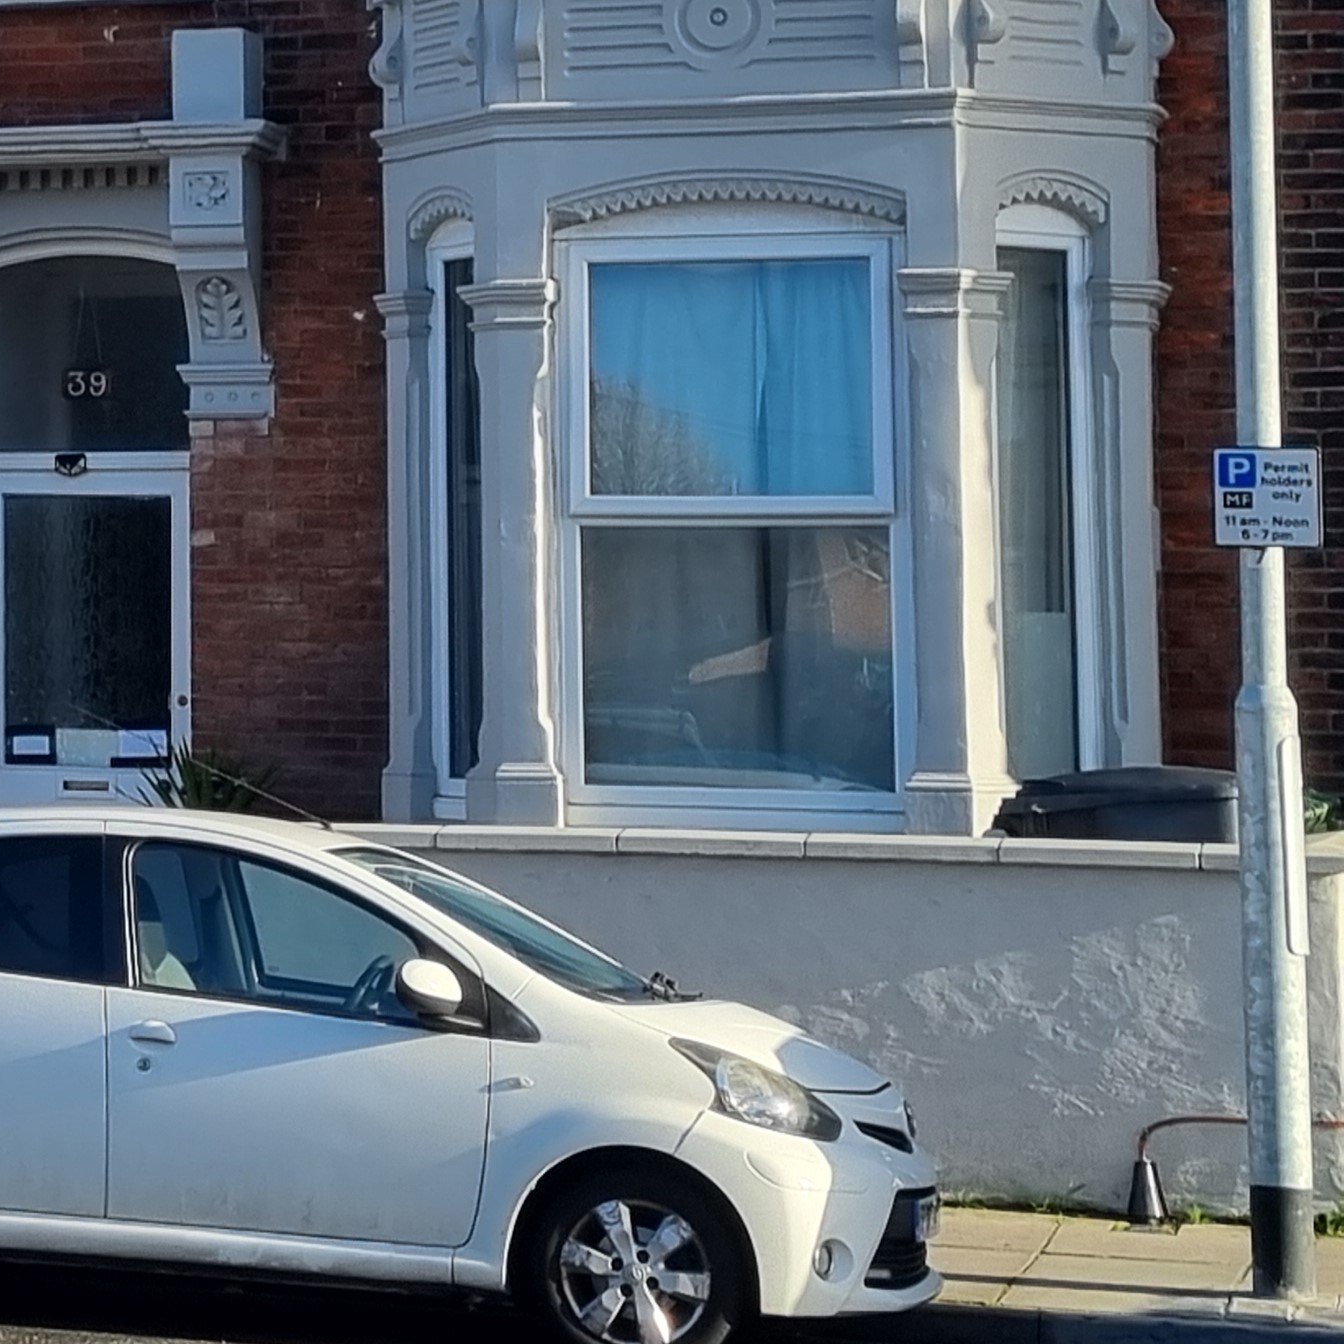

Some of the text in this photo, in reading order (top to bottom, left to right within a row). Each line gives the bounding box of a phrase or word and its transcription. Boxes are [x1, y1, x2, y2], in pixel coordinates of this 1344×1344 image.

[67, 371, 107, 397] 39
[1228, 457, 1250, 485] P
[1263, 461, 1309, 474] Permit
[1261, 476, 1312, 487] holders
[1272, 489, 1302, 503] only
[1272, 516, 1309, 528] Noon
